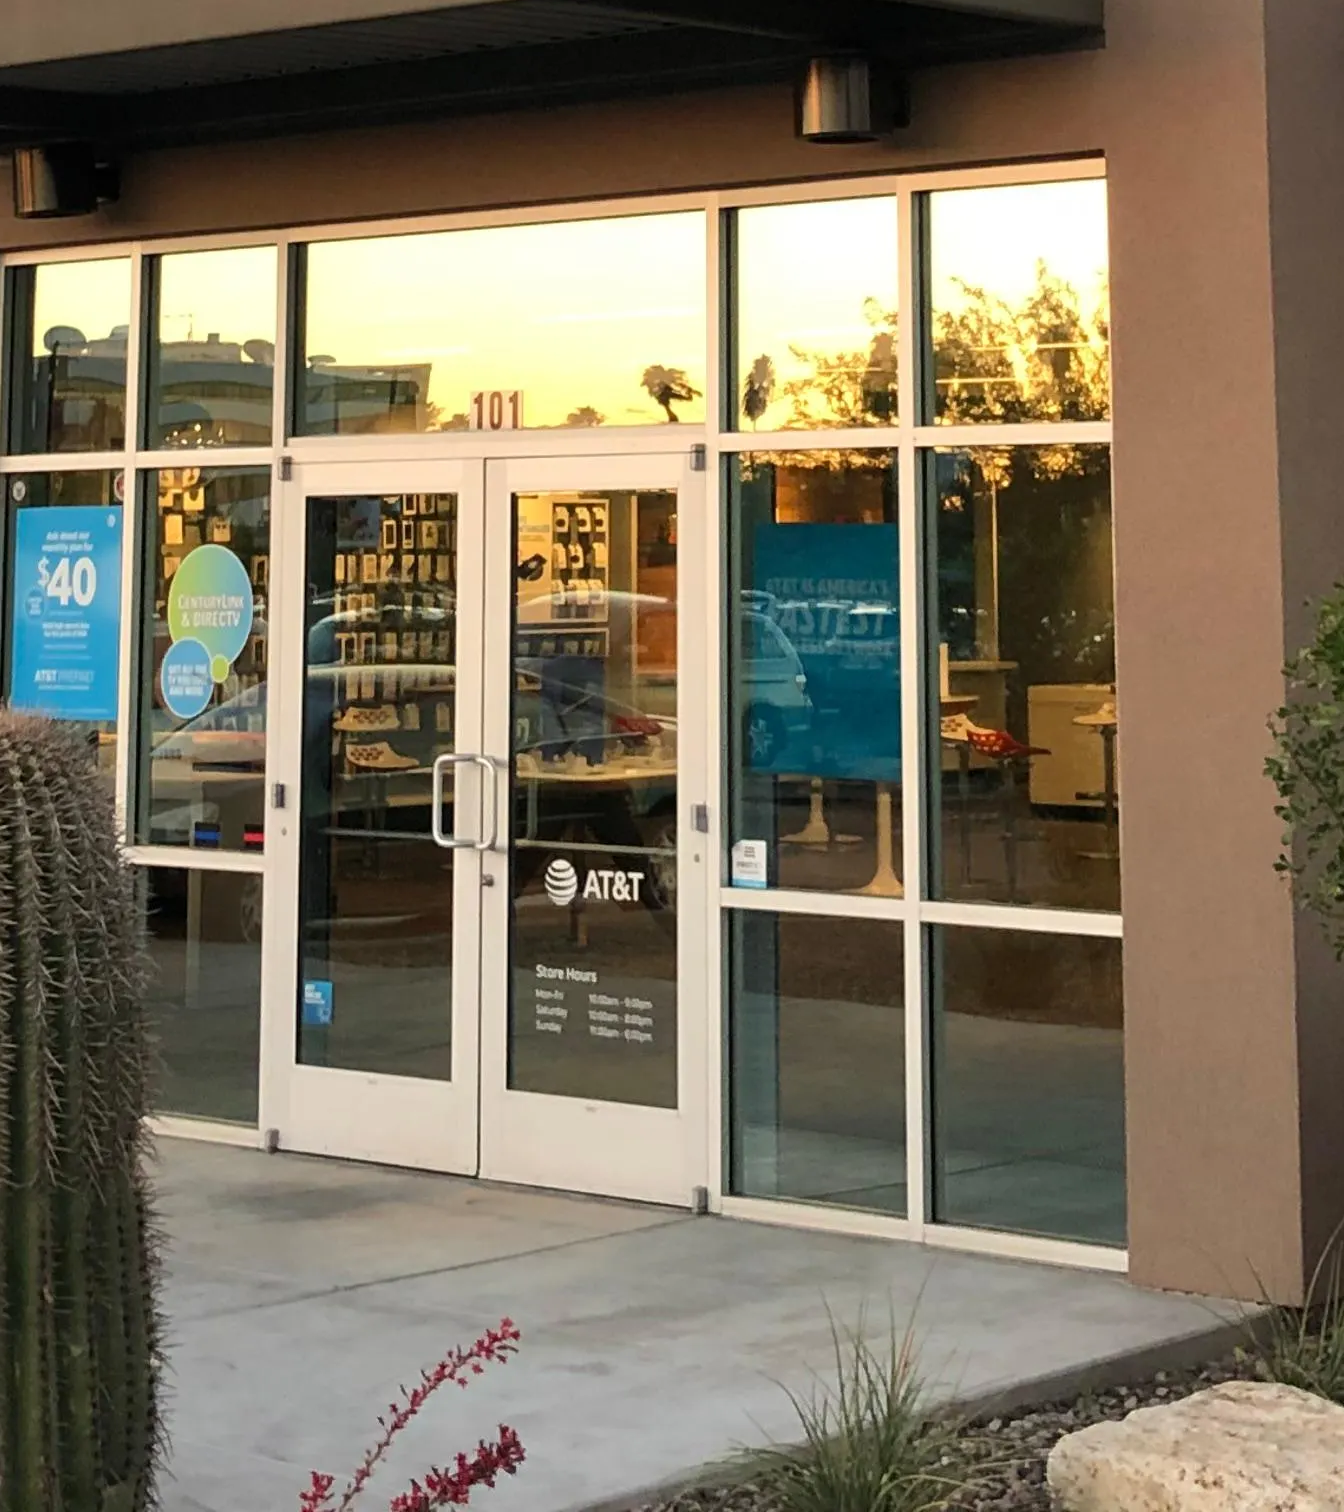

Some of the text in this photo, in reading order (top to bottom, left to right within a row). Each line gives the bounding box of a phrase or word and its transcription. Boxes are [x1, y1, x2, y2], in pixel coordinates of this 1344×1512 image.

[474, 390, 519, 430] 101
[37, 555, 97, 606] $40
[181, 610, 241, 627] & DIRECTV
[34, 669, 57, 683] AT&T
[583, 869, 645, 902] AT&T
[536, 963, 598, 983] Store Hours
[535, 1003, 568, 1020] Saturday
[535, 1019, 562, 1034] Sunday
